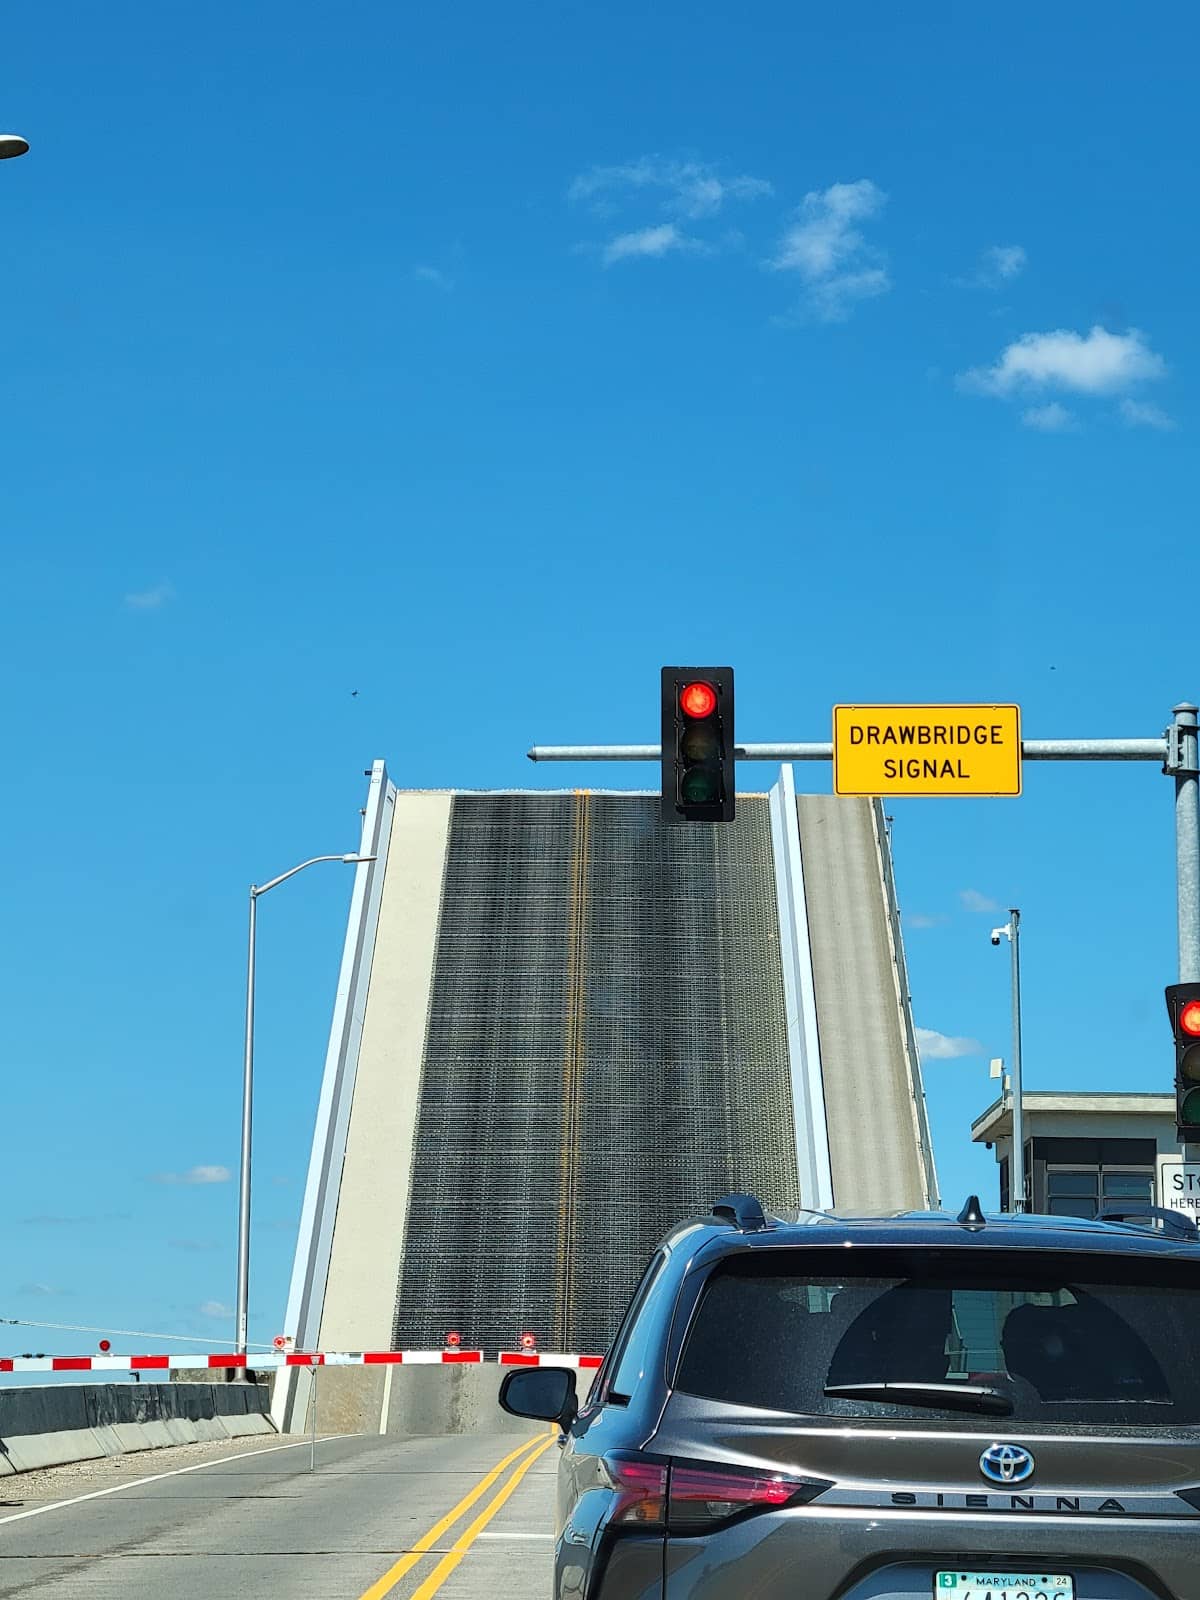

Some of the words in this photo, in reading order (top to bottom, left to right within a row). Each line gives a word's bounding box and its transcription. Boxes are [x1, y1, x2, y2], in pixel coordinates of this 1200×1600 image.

[850, 725, 1003, 745] DRAWBRIDGE
[884, 759, 971, 778] SIGNAL
[1173, 1173, 1200, 1191] ST
[1170, 1198, 1200, 1209] HERE
[891, 1492, 1126, 1513] SIENNA
[943, 1574, 953, 1586] 3
[976, 1577, 1036, 1587] MARYLAND
[1056, 1577, 1067, 1586] 24
